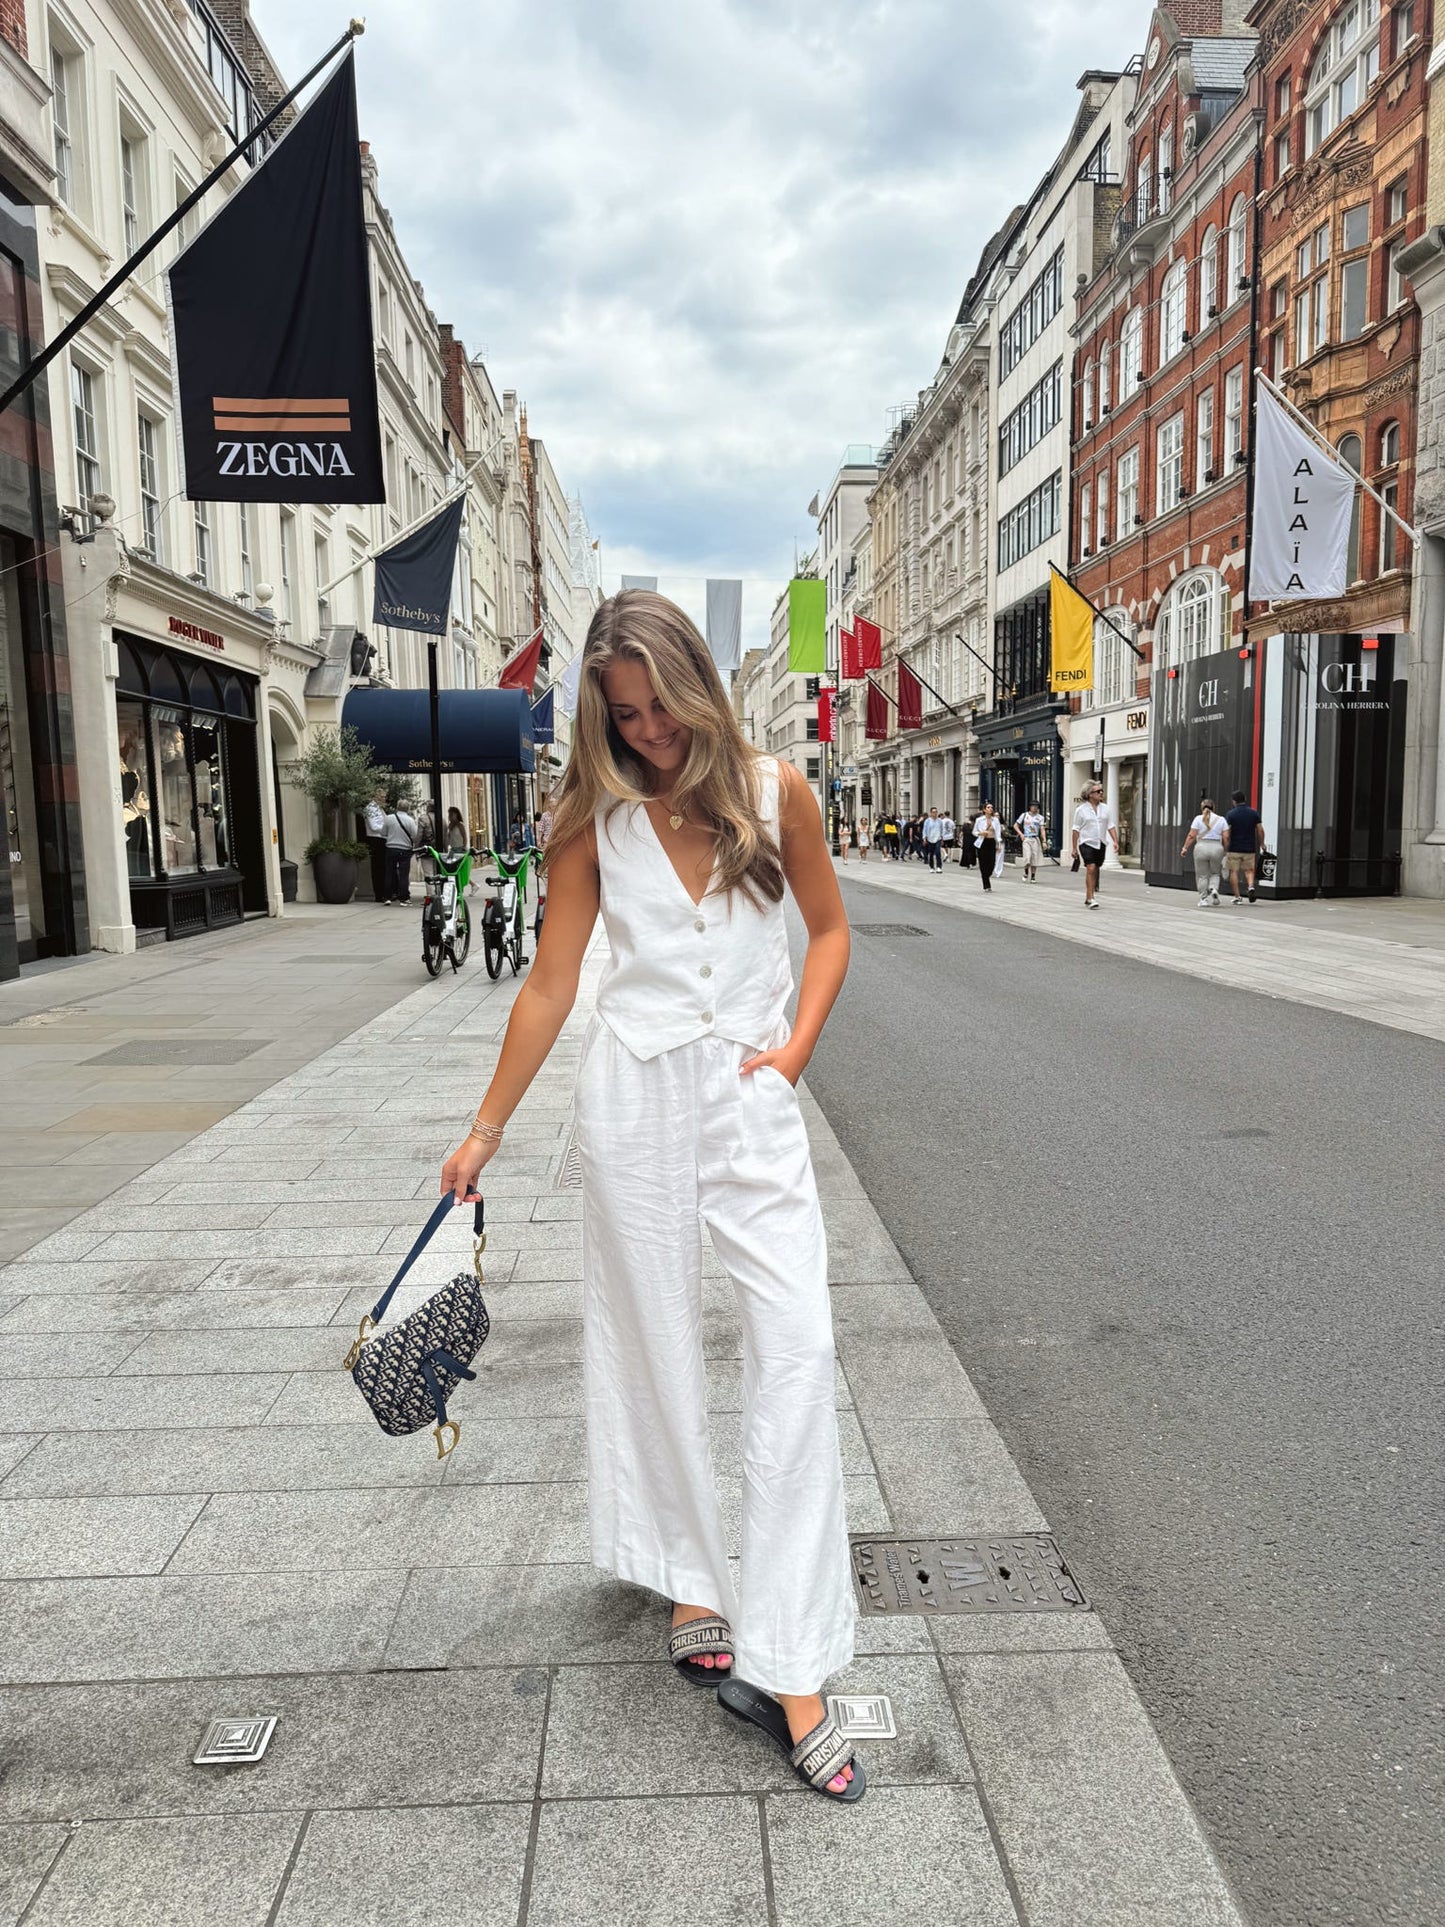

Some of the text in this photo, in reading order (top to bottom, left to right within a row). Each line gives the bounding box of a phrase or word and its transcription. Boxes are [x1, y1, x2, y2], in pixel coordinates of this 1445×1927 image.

[216, 441, 356, 477] ZEGNA
[1285, 458, 1314, 590] ALAÏA
[381, 602, 441, 625] Sotheby's
[1055, 669, 1087, 681] FENDI
[1321, 662, 1372, 693] CH
[1199, 678, 1220, 708] CH
[1346, 701, 1390, 710] HERRERA
[1127, 711, 1148, 731] FENDI
[894, 1572, 912, 1612] Thames
[671, 1628, 720, 1653] CHRISTIAN
[802, 1728, 846, 1776] CHRISTIAN
